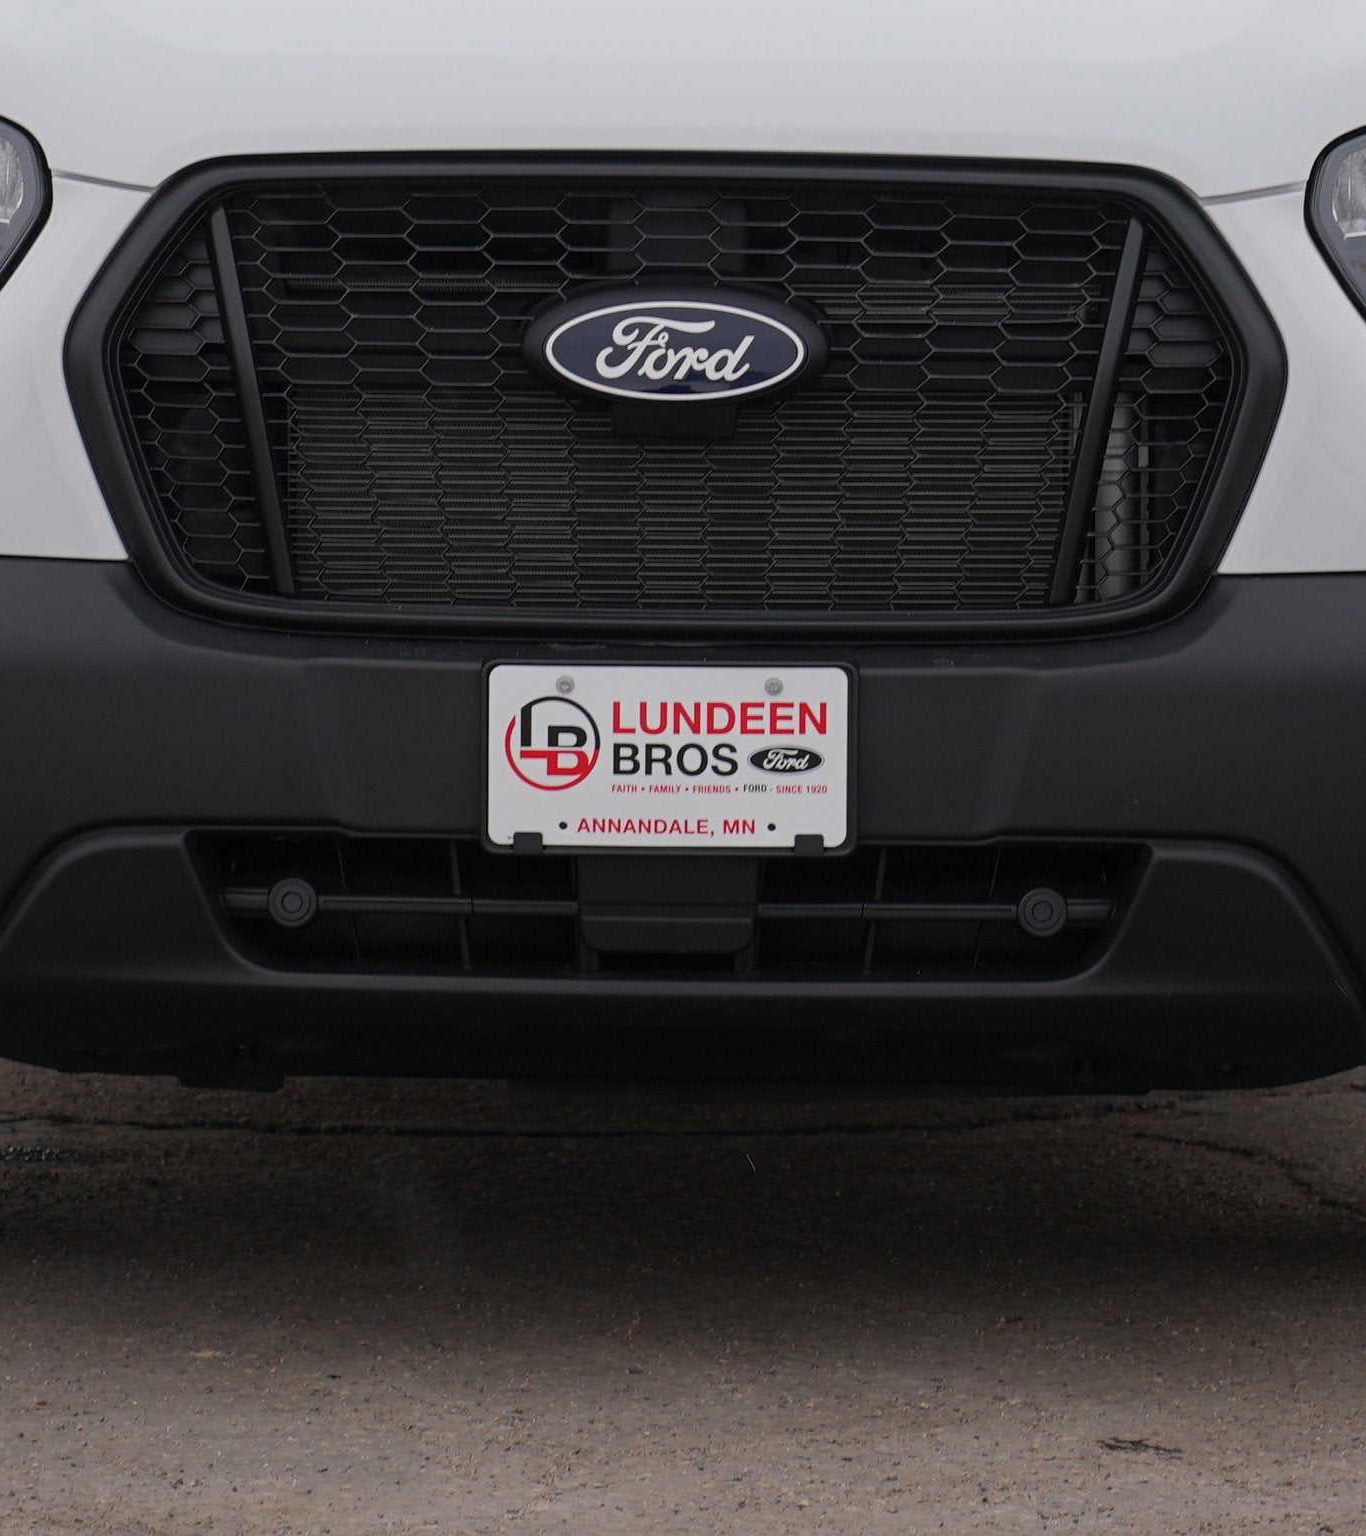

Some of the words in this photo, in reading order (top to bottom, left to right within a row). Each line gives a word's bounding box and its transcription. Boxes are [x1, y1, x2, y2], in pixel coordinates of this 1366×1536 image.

[595, 316, 754, 382] Ford
[612, 701, 829, 735] LUNDEEN
[612, 742, 739, 777] BROS
[762, 746, 810, 772] Ford
[611, 784, 638, 794] FAITH
[648, 784, 681, 794] FAMILY
[692, 784, 732, 794] FRIENDS
[742, 783, 767, 794] FORD
[775, 784, 803, 794] SINCE
[806, 784, 828, 794] 1920
[577, 817, 715, 836] ANNANDALE,
[722, 818, 756, 834] MN
